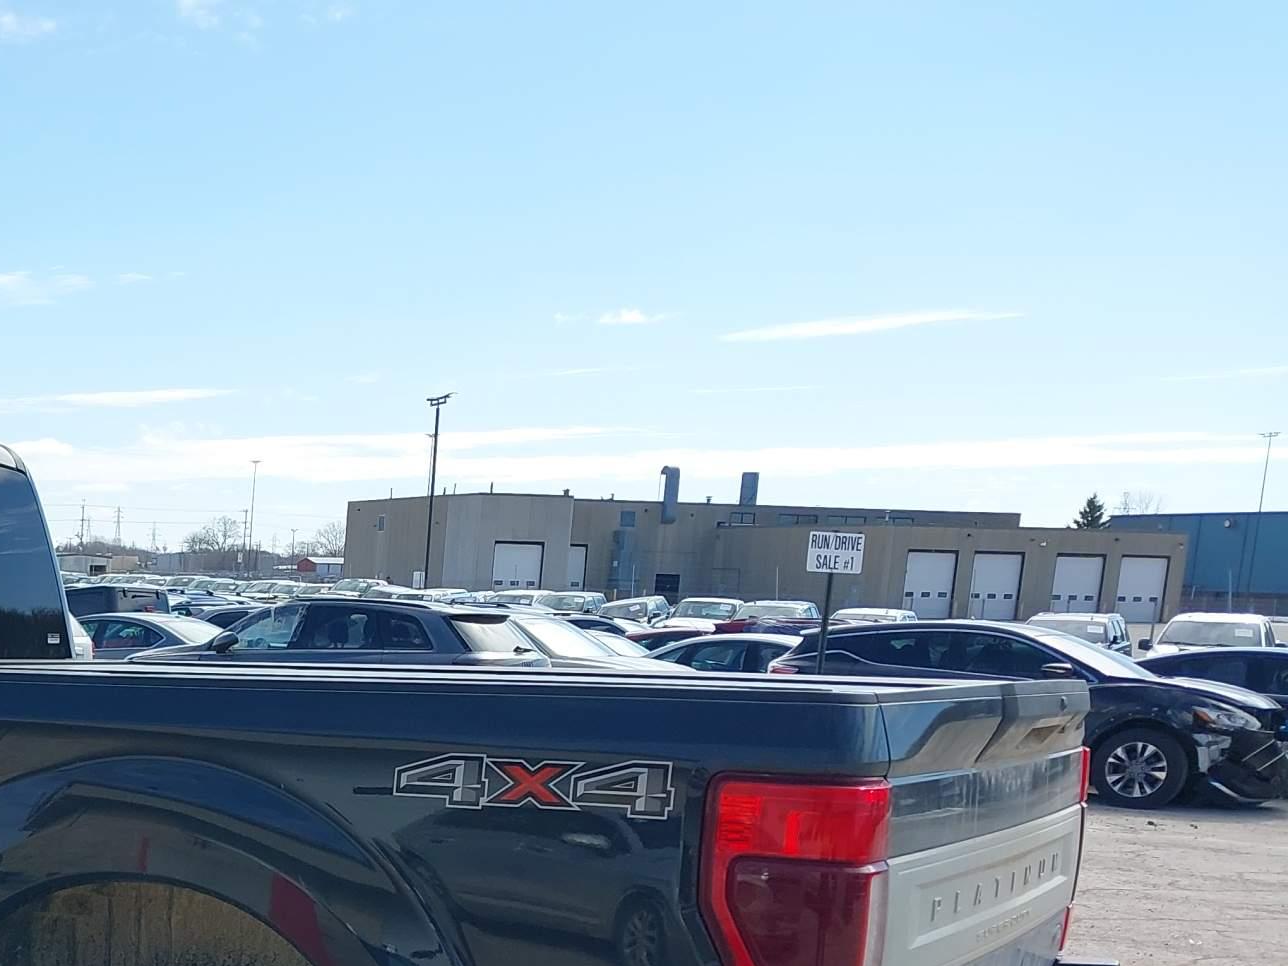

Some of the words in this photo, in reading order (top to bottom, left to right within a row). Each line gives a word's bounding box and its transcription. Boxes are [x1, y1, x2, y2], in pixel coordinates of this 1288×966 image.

[811, 534, 863, 551] RUN/DRIVE
[815, 553, 840, 570] SALE
[843, 556, 854, 570] #1
[930, 852, 1059, 922] PLATINUM
